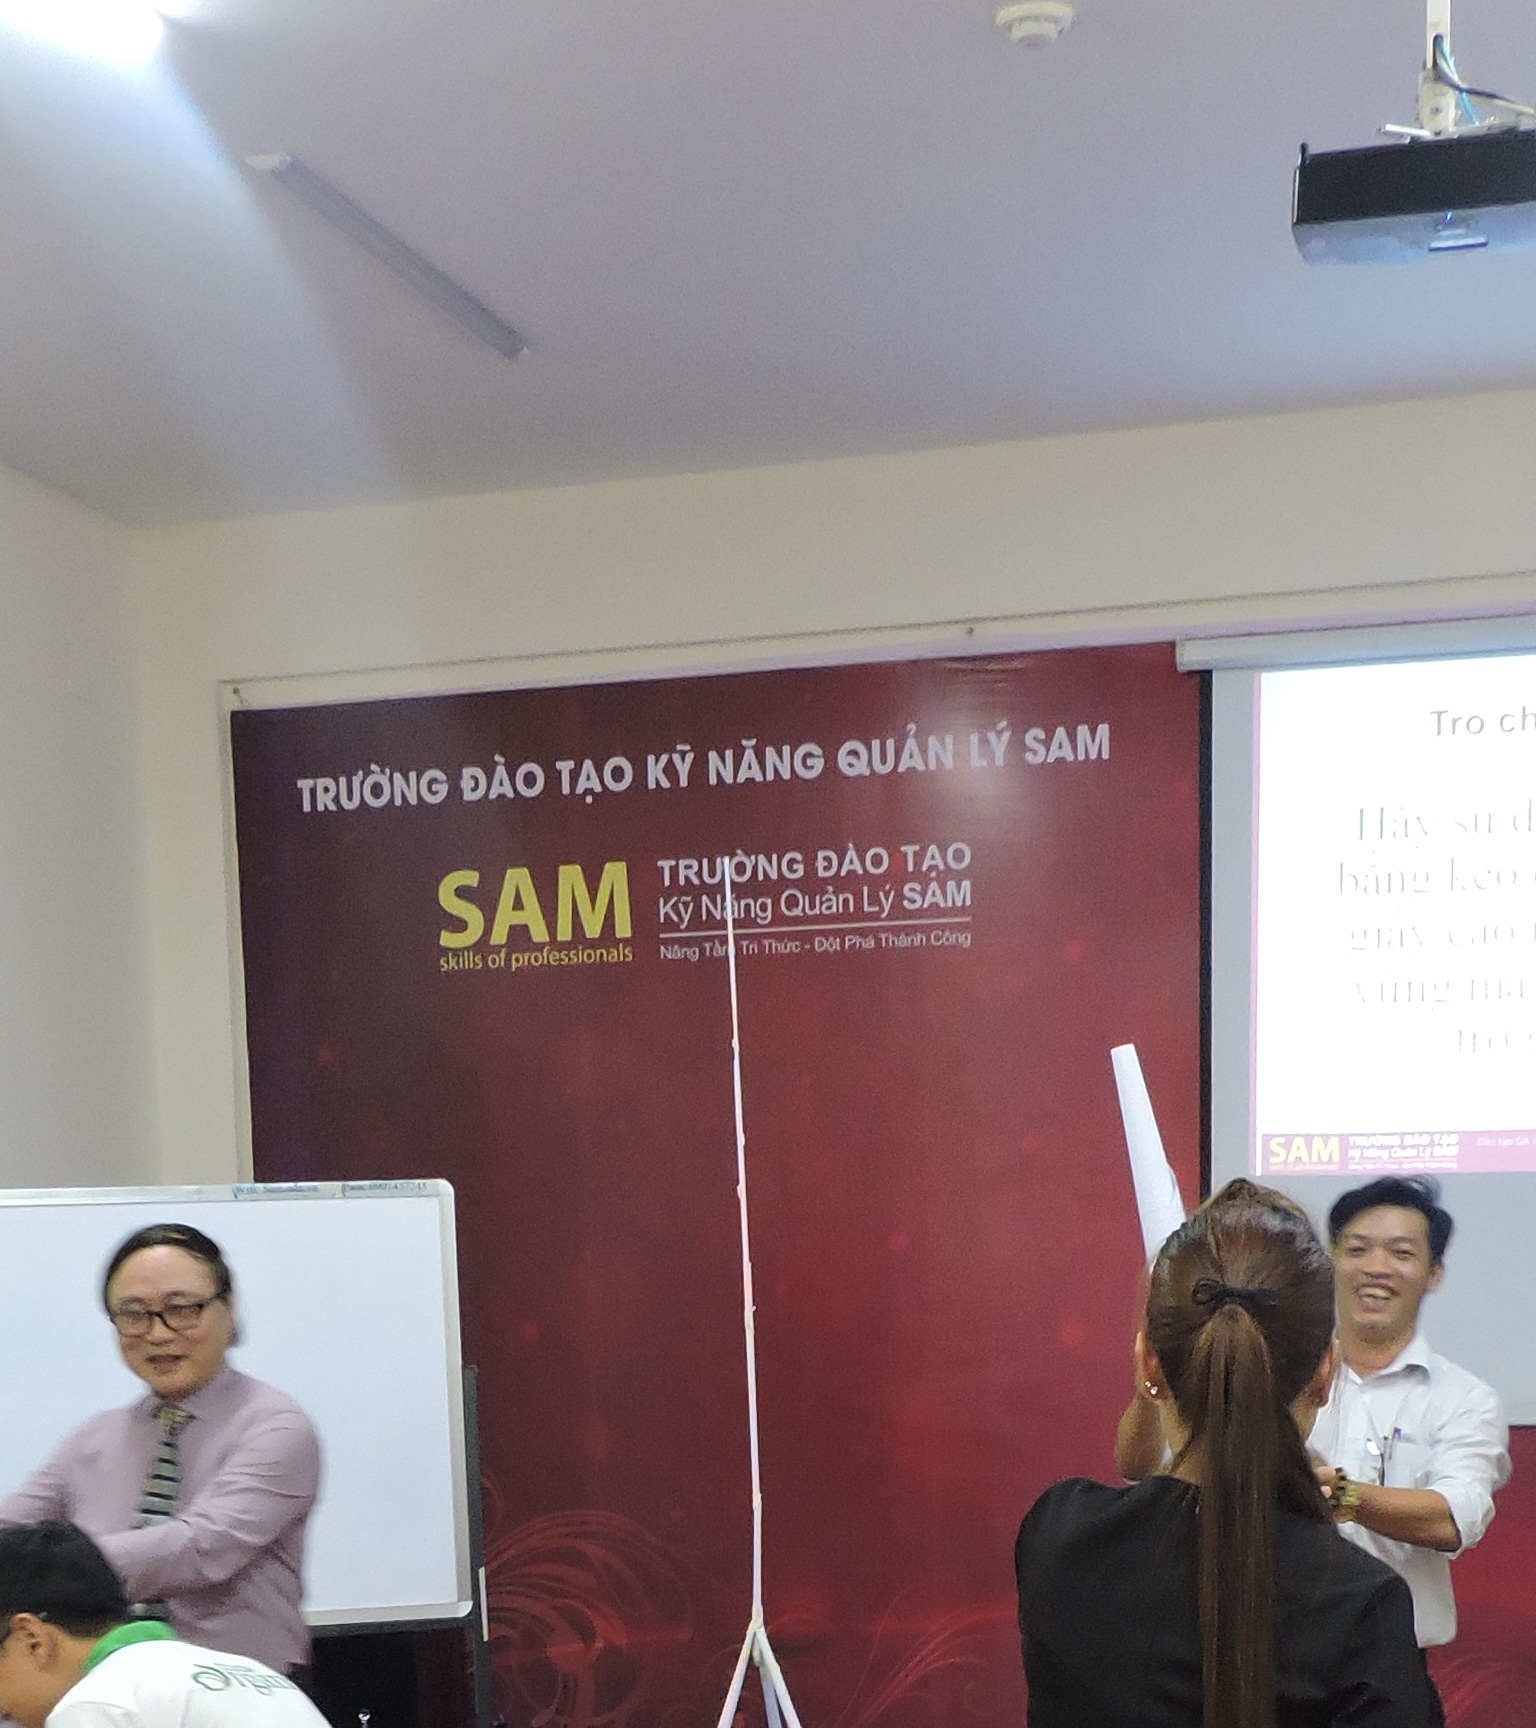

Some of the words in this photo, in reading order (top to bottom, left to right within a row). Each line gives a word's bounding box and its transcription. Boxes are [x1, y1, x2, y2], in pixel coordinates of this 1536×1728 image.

[297, 763, 449, 813] TRƯỜNG
[460, 753, 545, 802] ĐÀO
[555, 755, 634, 805] TẠO
[646, 742, 695, 791] KỸ
[707, 738, 825, 786] NĂNG
[837, 722, 954, 778] QUẢN
[969, 719, 1013, 769] LÝ
[1024, 723, 1111, 766] SAM
[815, 842, 890, 878] ĐÀO
[900, 842, 972, 878] TẠO
[438, 861, 632, 948] SAM
[658, 894, 695, 930] Kỹ
[780, 885, 855, 918] Quản
[862, 883, 895, 919] Lý
[902, 880, 972, 911] SAM
[439, 948, 483, 972] skills
[487, 946, 507, 970] of
[511, 942, 634, 973] professionals
[1268, 1135, 1341, 1164] SAM
